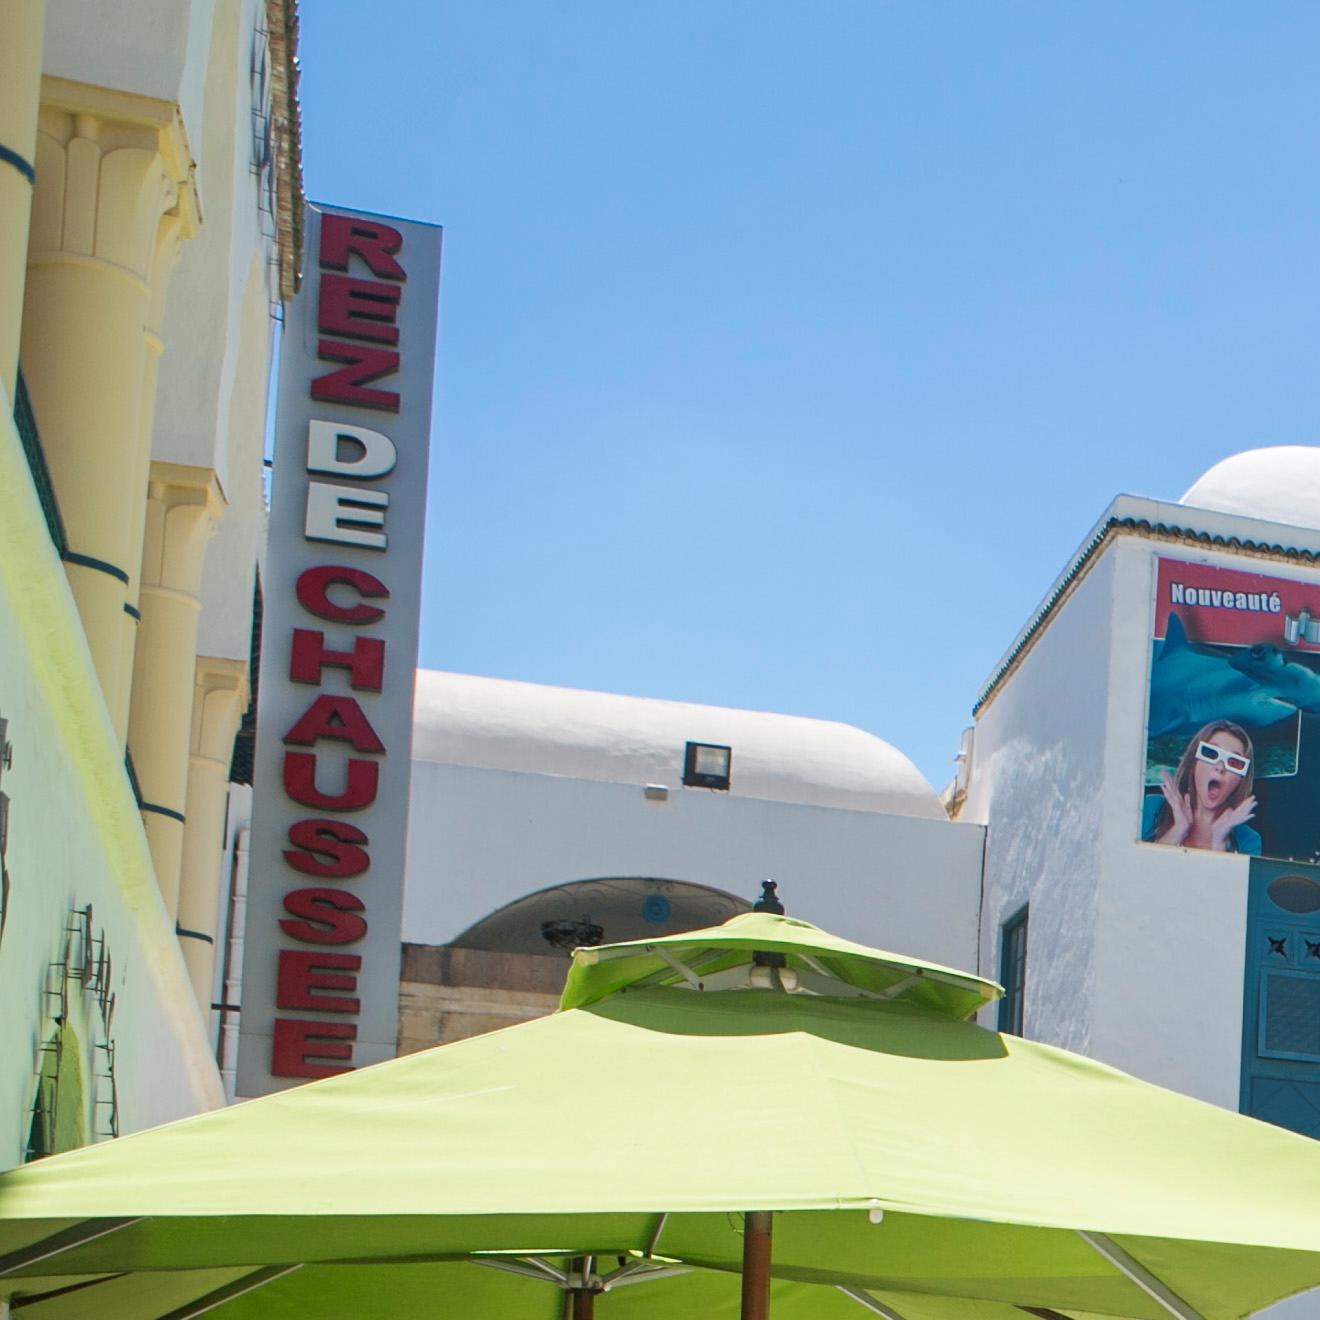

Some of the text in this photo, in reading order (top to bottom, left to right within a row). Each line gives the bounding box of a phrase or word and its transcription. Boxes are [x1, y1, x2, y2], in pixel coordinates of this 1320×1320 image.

[271, 213, 408, 1080] REZ DE CHAUSSEE
[1170, 582, 1282, 615] Nouveauté
